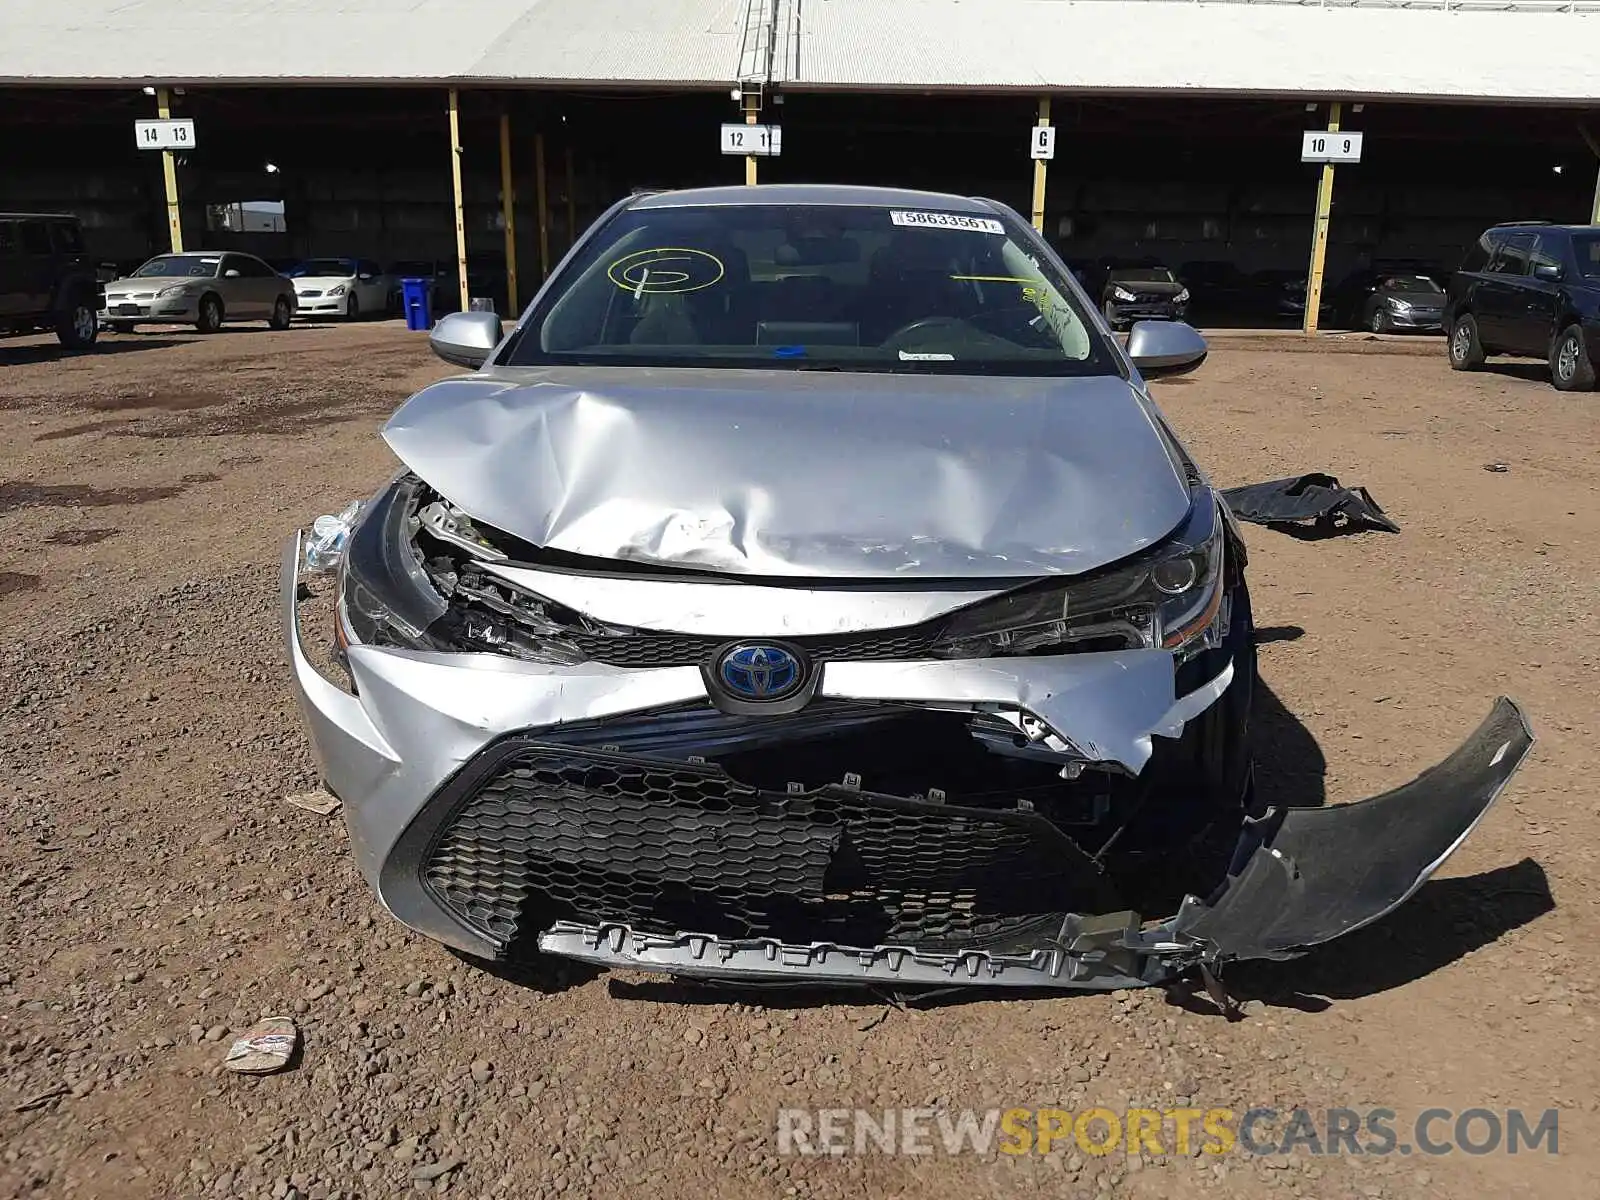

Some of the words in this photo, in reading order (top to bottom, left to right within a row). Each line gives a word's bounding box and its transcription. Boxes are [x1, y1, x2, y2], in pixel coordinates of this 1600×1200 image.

[144, 128, 157, 142] 14
[172, 127, 187, 141] 13
[730, 132, 743, 146] 12
[1039, 131, 1047, 147] G
[1312, 139, 1325, 152] 10
[1343, 139, 1351, 153] 9
[905, 213, 988, 229] 58633561
